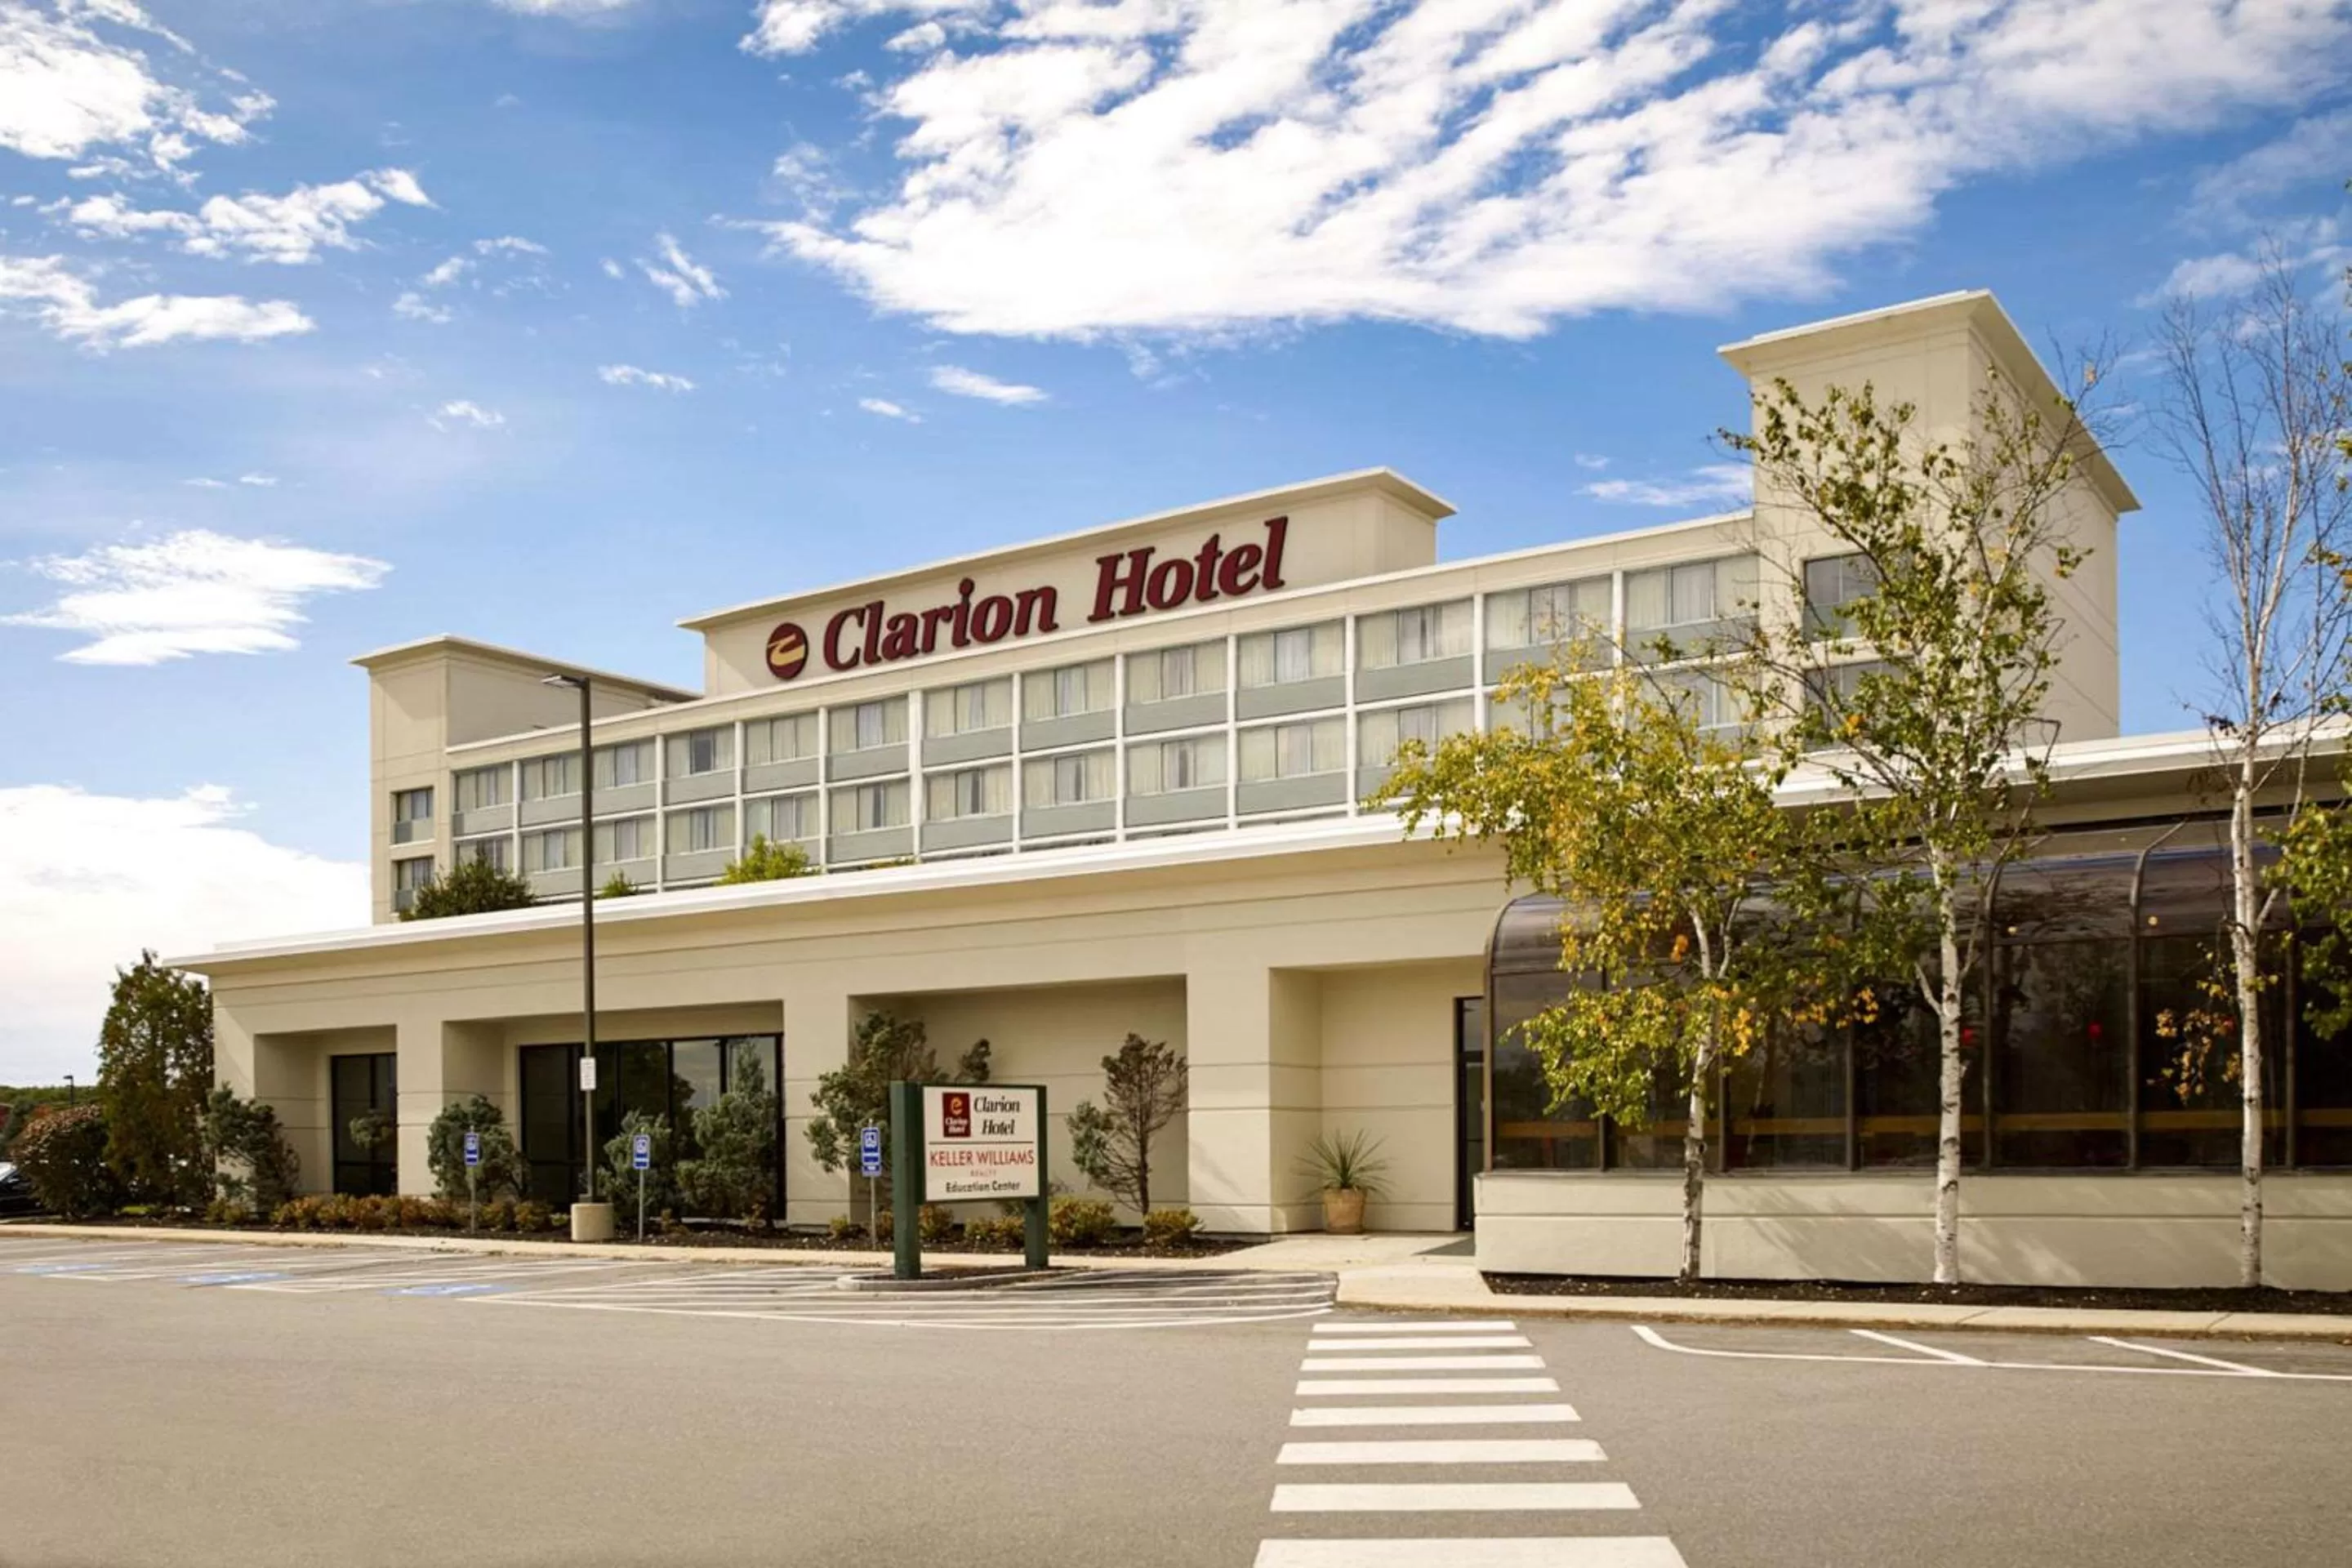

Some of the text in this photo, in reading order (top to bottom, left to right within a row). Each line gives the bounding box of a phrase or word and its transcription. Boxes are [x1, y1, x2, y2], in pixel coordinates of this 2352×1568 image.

[822, 516, 1289, 671] Clarion Hotel
[973, 1095, 1020, 1113] Clarion
[982, 1119, 1015, 1135] Hotel
[929, 1150, 1035, 1167] KELLER WILLIAMS
[946, 1181, 1021, 1192] Education Center
